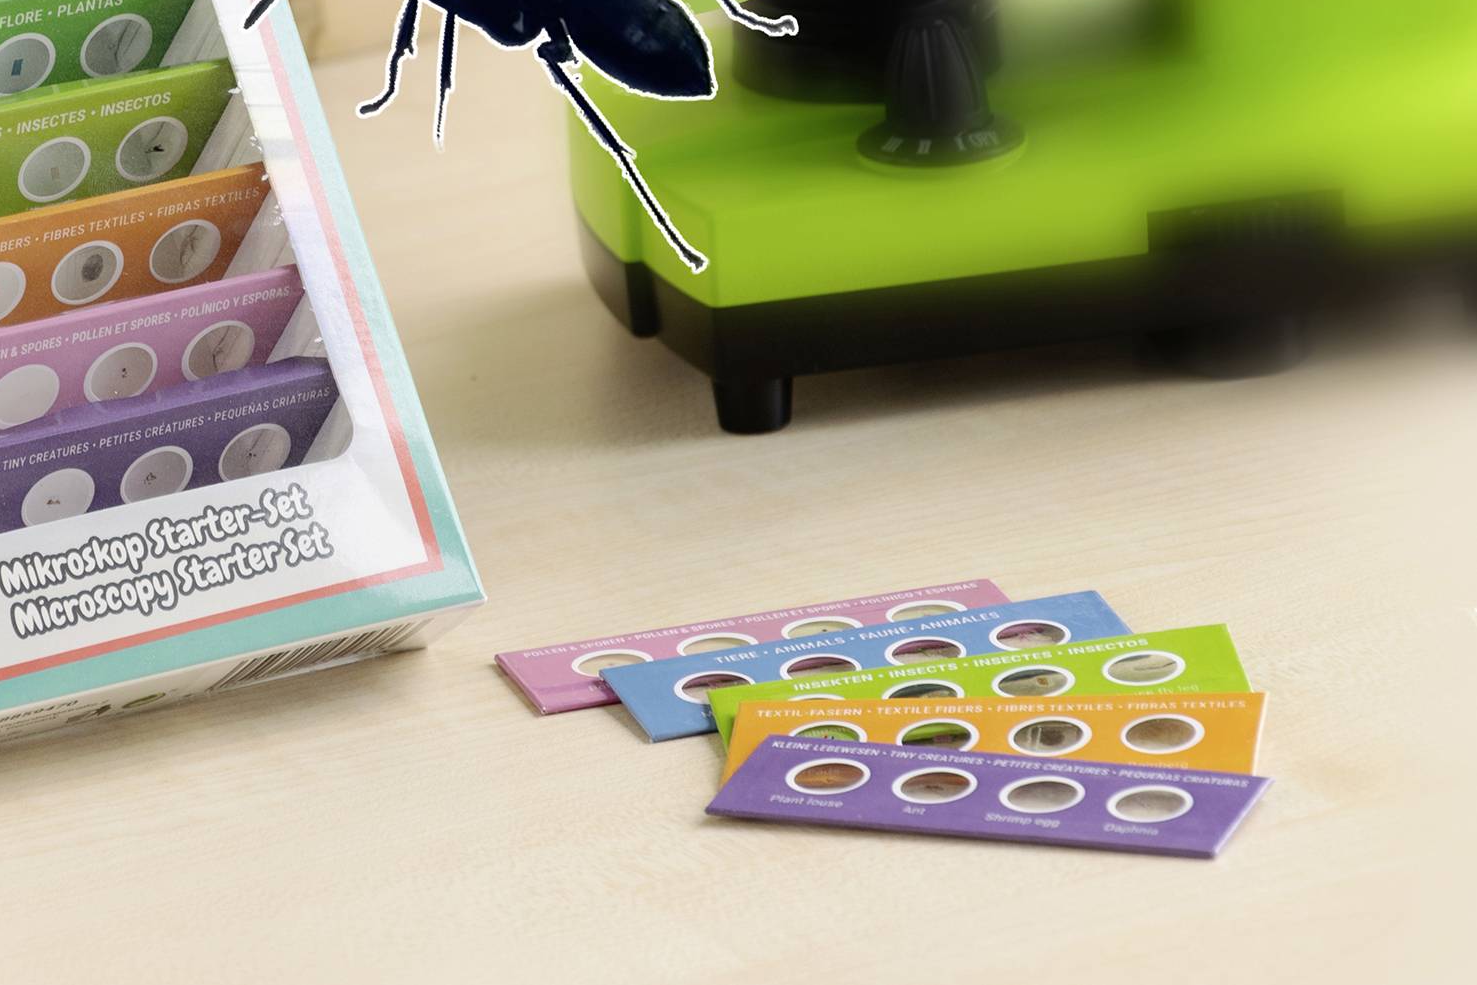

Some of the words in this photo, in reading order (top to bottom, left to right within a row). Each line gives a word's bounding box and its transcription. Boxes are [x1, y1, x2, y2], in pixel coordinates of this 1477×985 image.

[16, 109, 86, 135] INSECTES
[99, 92, 171, 117] INSECTOS
[43, 224, 85, 243] FIBRES
[89, 211, 145, 232] TEXTILES
[156, 199, 200, 218] FIBRAS
[203, 185, 260, 207] TEXTILES
[10, 346, 18, 357] &
[21, 335, 62, 356] SPORES
[72, 327, 112, 345] POLLEN
[114, 321, 127, 334] ET
[130, 311, 171, 331] SPORES
[180, 299, 230, 319] POLÍNICO
[233, 294, 241, 306] Y
[242, 285, 290, 306] ESPORAS
[2, 455, 26, 471] TINY
[28, 441, 90, 465] CREATURES
[99, 430, 142, 449] PETITES
[144, 416, 204, 438] CRÉATURES
[213, 399, 270, 423] PEQUEÑAS
[271, 386, 330, 408] CRIATURAS
[145, 483, 313, 556] Starter-Set
[10, 569, 178, 639] Microscopy
[175, 539, 281, 596] Starter
[280, 521, 335, 565] Set
[524, 646, 567, 659] POLLEN
[635, 628, 679, 641] POLLEN
[715, 650, 759, 665] TIERE
[774, 636, 846, 655] ANIMALS
[859, 626, 907, 641] FAUNE
[920, 611, 1000, 631] ANIMALES
[793, 672, 874, 692] INSEKTEN
[888, 661, 959, 679] INSECTS
[974, 650, 1053, 668] INSECTES
[1067, 638, 1149, 656] INSECTOS
[756, 707, 863, 718] TEXTIL-FASERN
[877, 705, 932, 715] TEXTILE
[935, 704, 983, 714] FIBERS
[996, 703, 1045, 713] FIBRES
[1049, 702, 1113, 712] TEXTILES
[1127, 701, 1177, 711] FIBRAS
[1181, 699, 1246, 709] TEXTILES
[771, 739, 813, 752] KLEINE
[815, 743, 880, 757] LEBEWESEN
[890, 749, 917, 760] TINY
[917, 752, 984, 766] CREATURES
[993, 757, 1042, 769] PETITES
